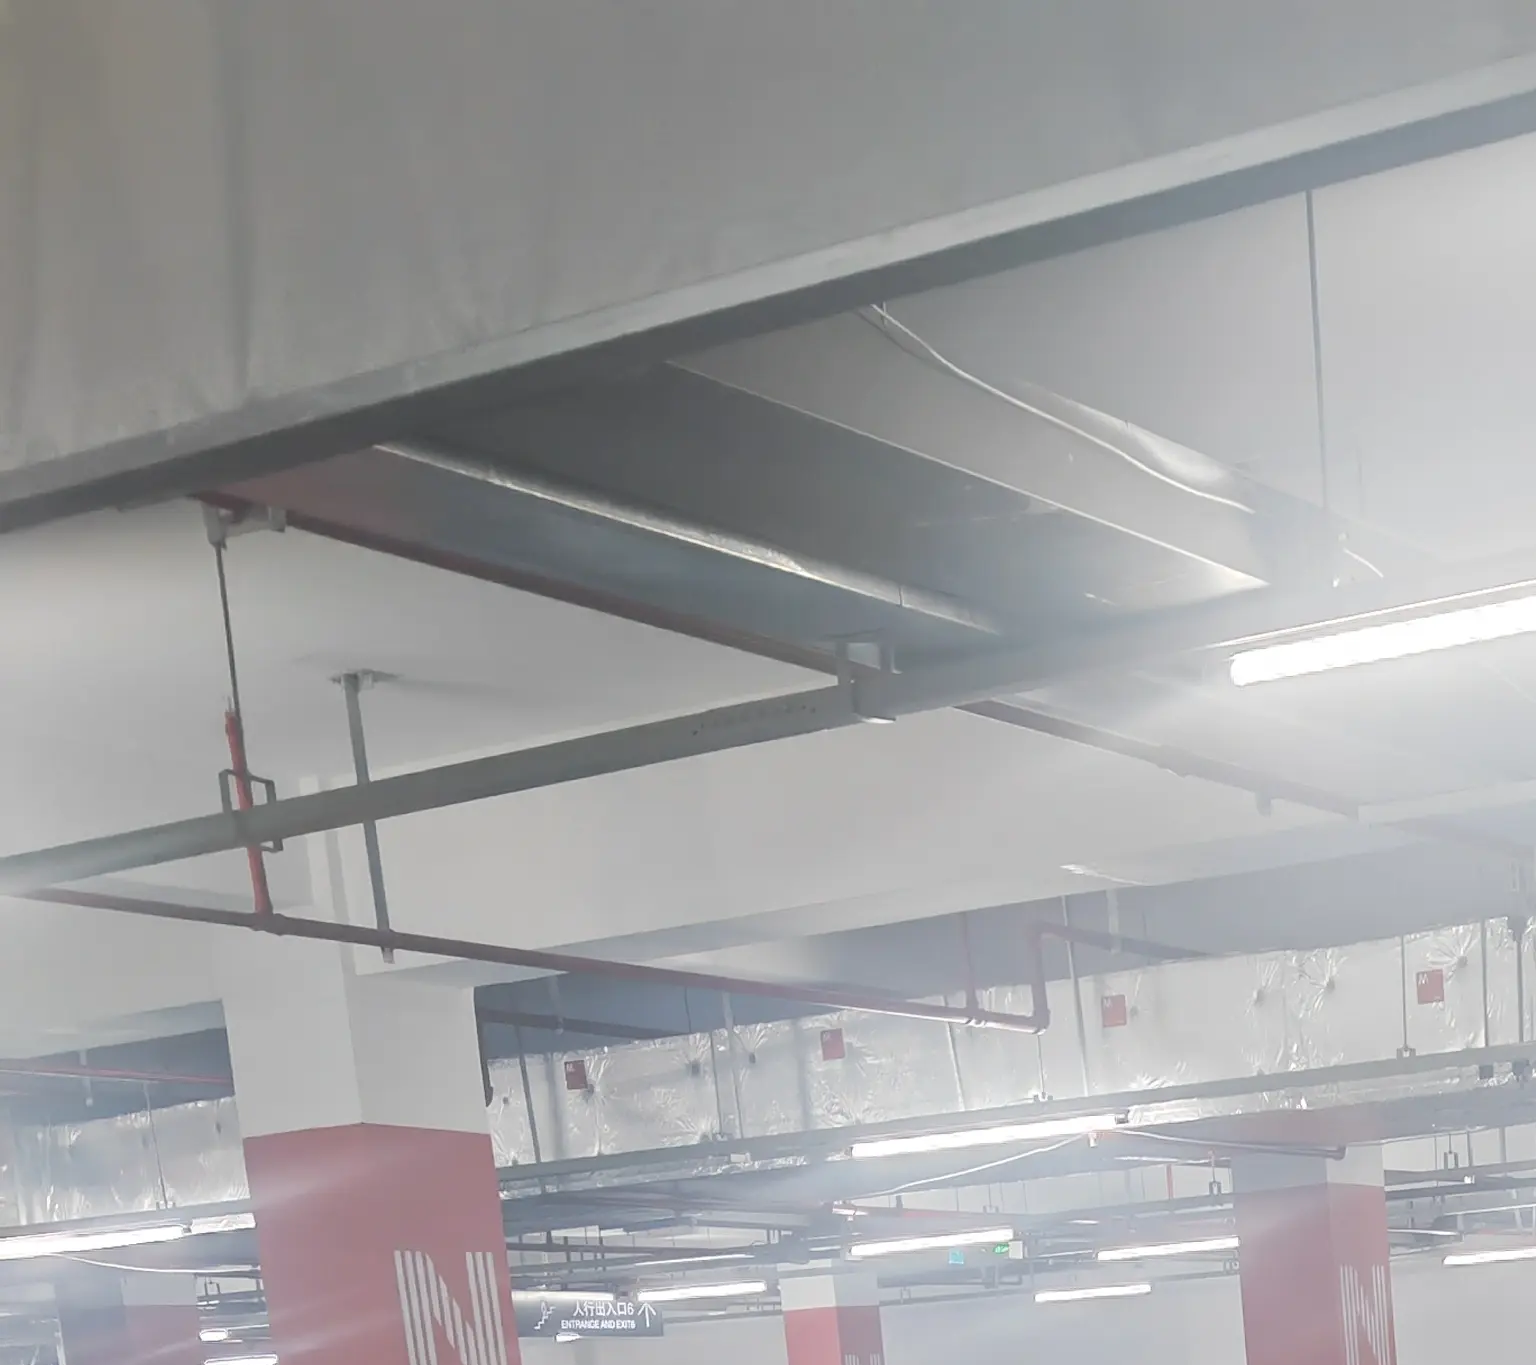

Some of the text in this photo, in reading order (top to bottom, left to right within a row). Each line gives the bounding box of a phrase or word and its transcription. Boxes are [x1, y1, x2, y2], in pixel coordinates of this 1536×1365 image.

[573, 1300, 635, 1316] 人行出入口6
[561, 1319, 600, 1329] ENTRANCE
[600, 1319, 615, 1329] AND
